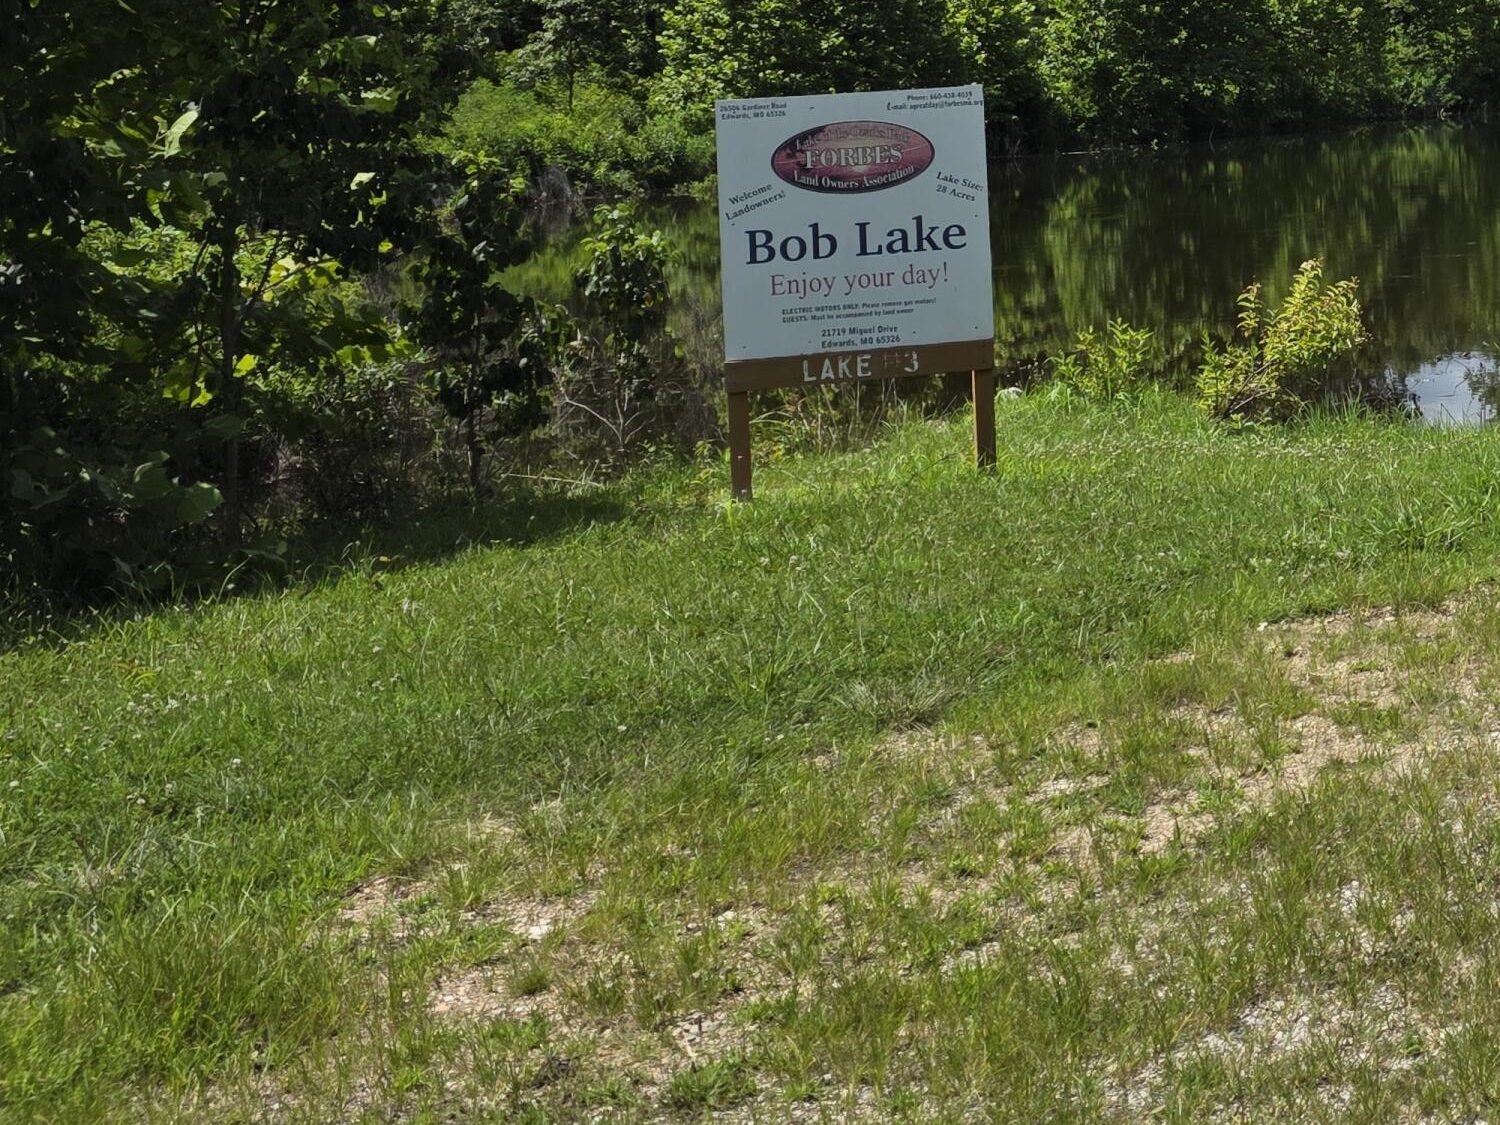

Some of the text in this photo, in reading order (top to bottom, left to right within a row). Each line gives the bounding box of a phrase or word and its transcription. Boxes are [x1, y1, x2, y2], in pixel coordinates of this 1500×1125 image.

[805, 144, 903, 169] FORBES
[793, 165, 914, 189] Land Owners Association
[936, 171, 984, 191] Lake Size:
[725, 189, 787, 221] Landowners!
[728, 184, 772, 205] Welcome
[936, 184, 975, 202] 28 Acres
[744, 215, 968, 265] Bob Lake
[770, 262, 949, 299] Enjoy your day!
[821, 325, 898, 337] 21719 Miguel Drive
[821, 335, 901, 349] Edwards, MO 65326
[803, 354, 872, 382] LAKE
